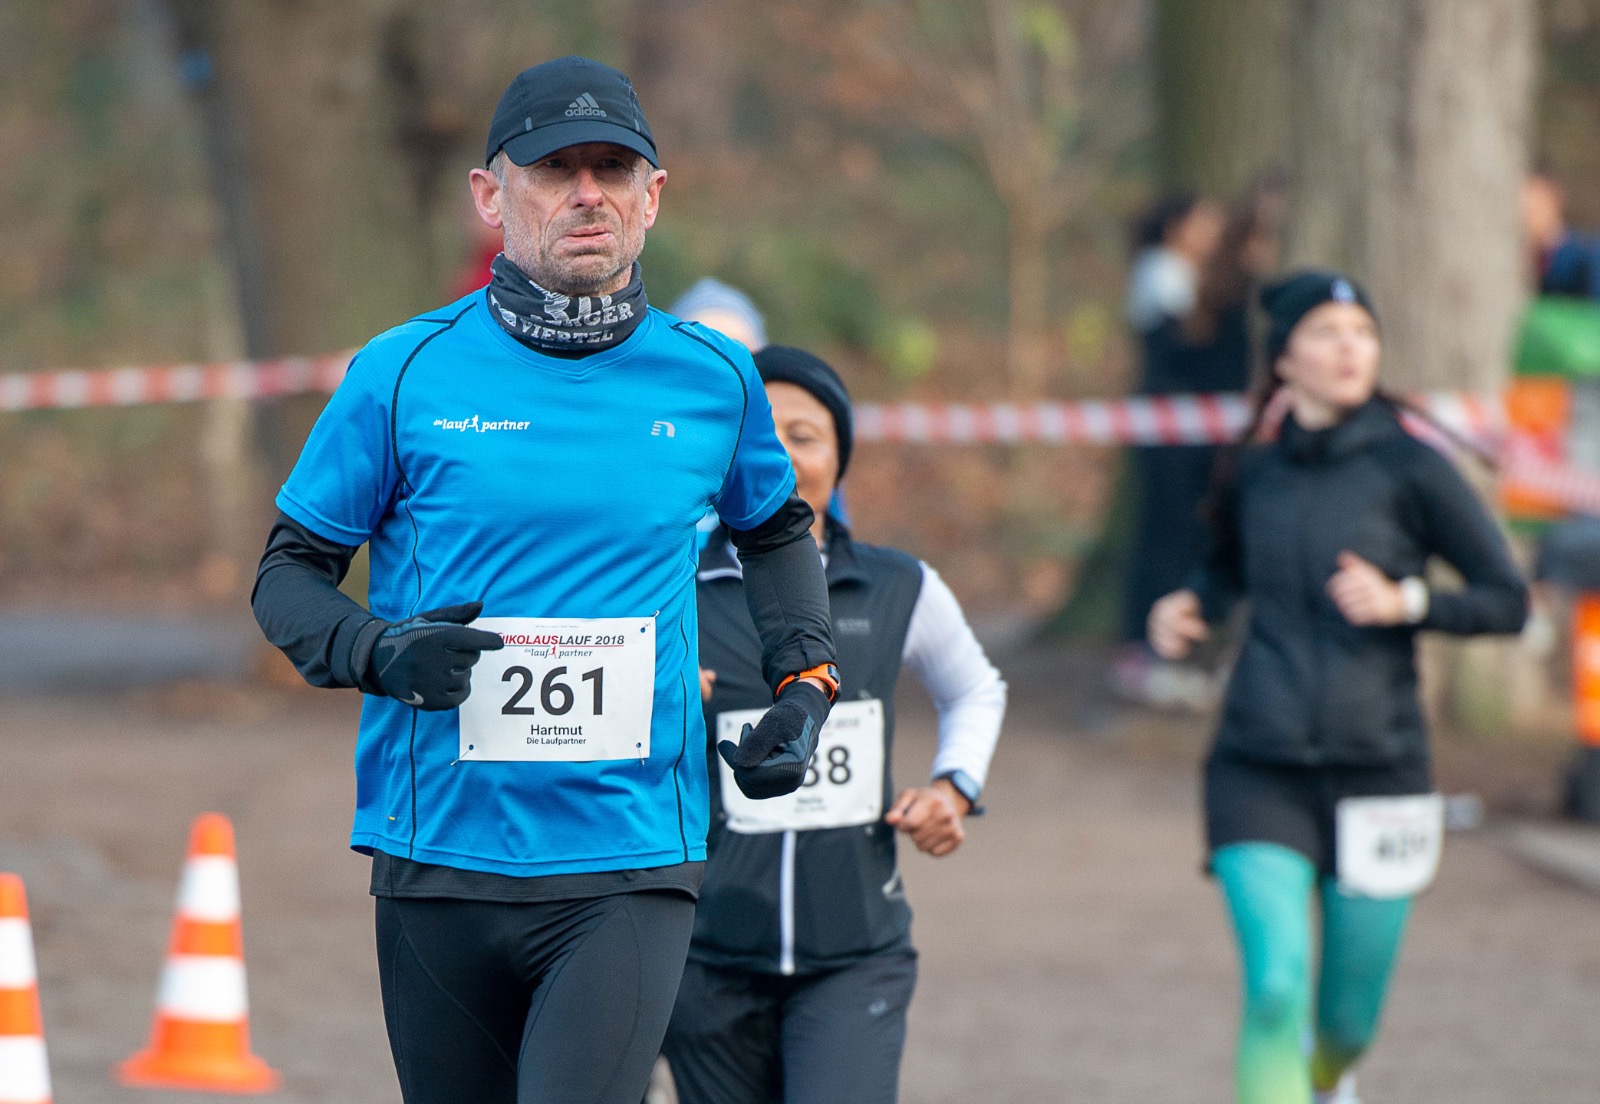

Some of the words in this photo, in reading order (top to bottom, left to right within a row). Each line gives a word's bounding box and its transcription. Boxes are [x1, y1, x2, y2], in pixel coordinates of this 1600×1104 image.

[565, 107, 607, 117] adidas
[520, 318, 613, 343] VIERTEL
[595, 635, 624, 645] 2018
[501, 665, 604, 716] 261
[530, 724, 583, 736] Hartmut
[526, 737, 539, 745] Die
[541, 737, 587, 746] Laufpartner
